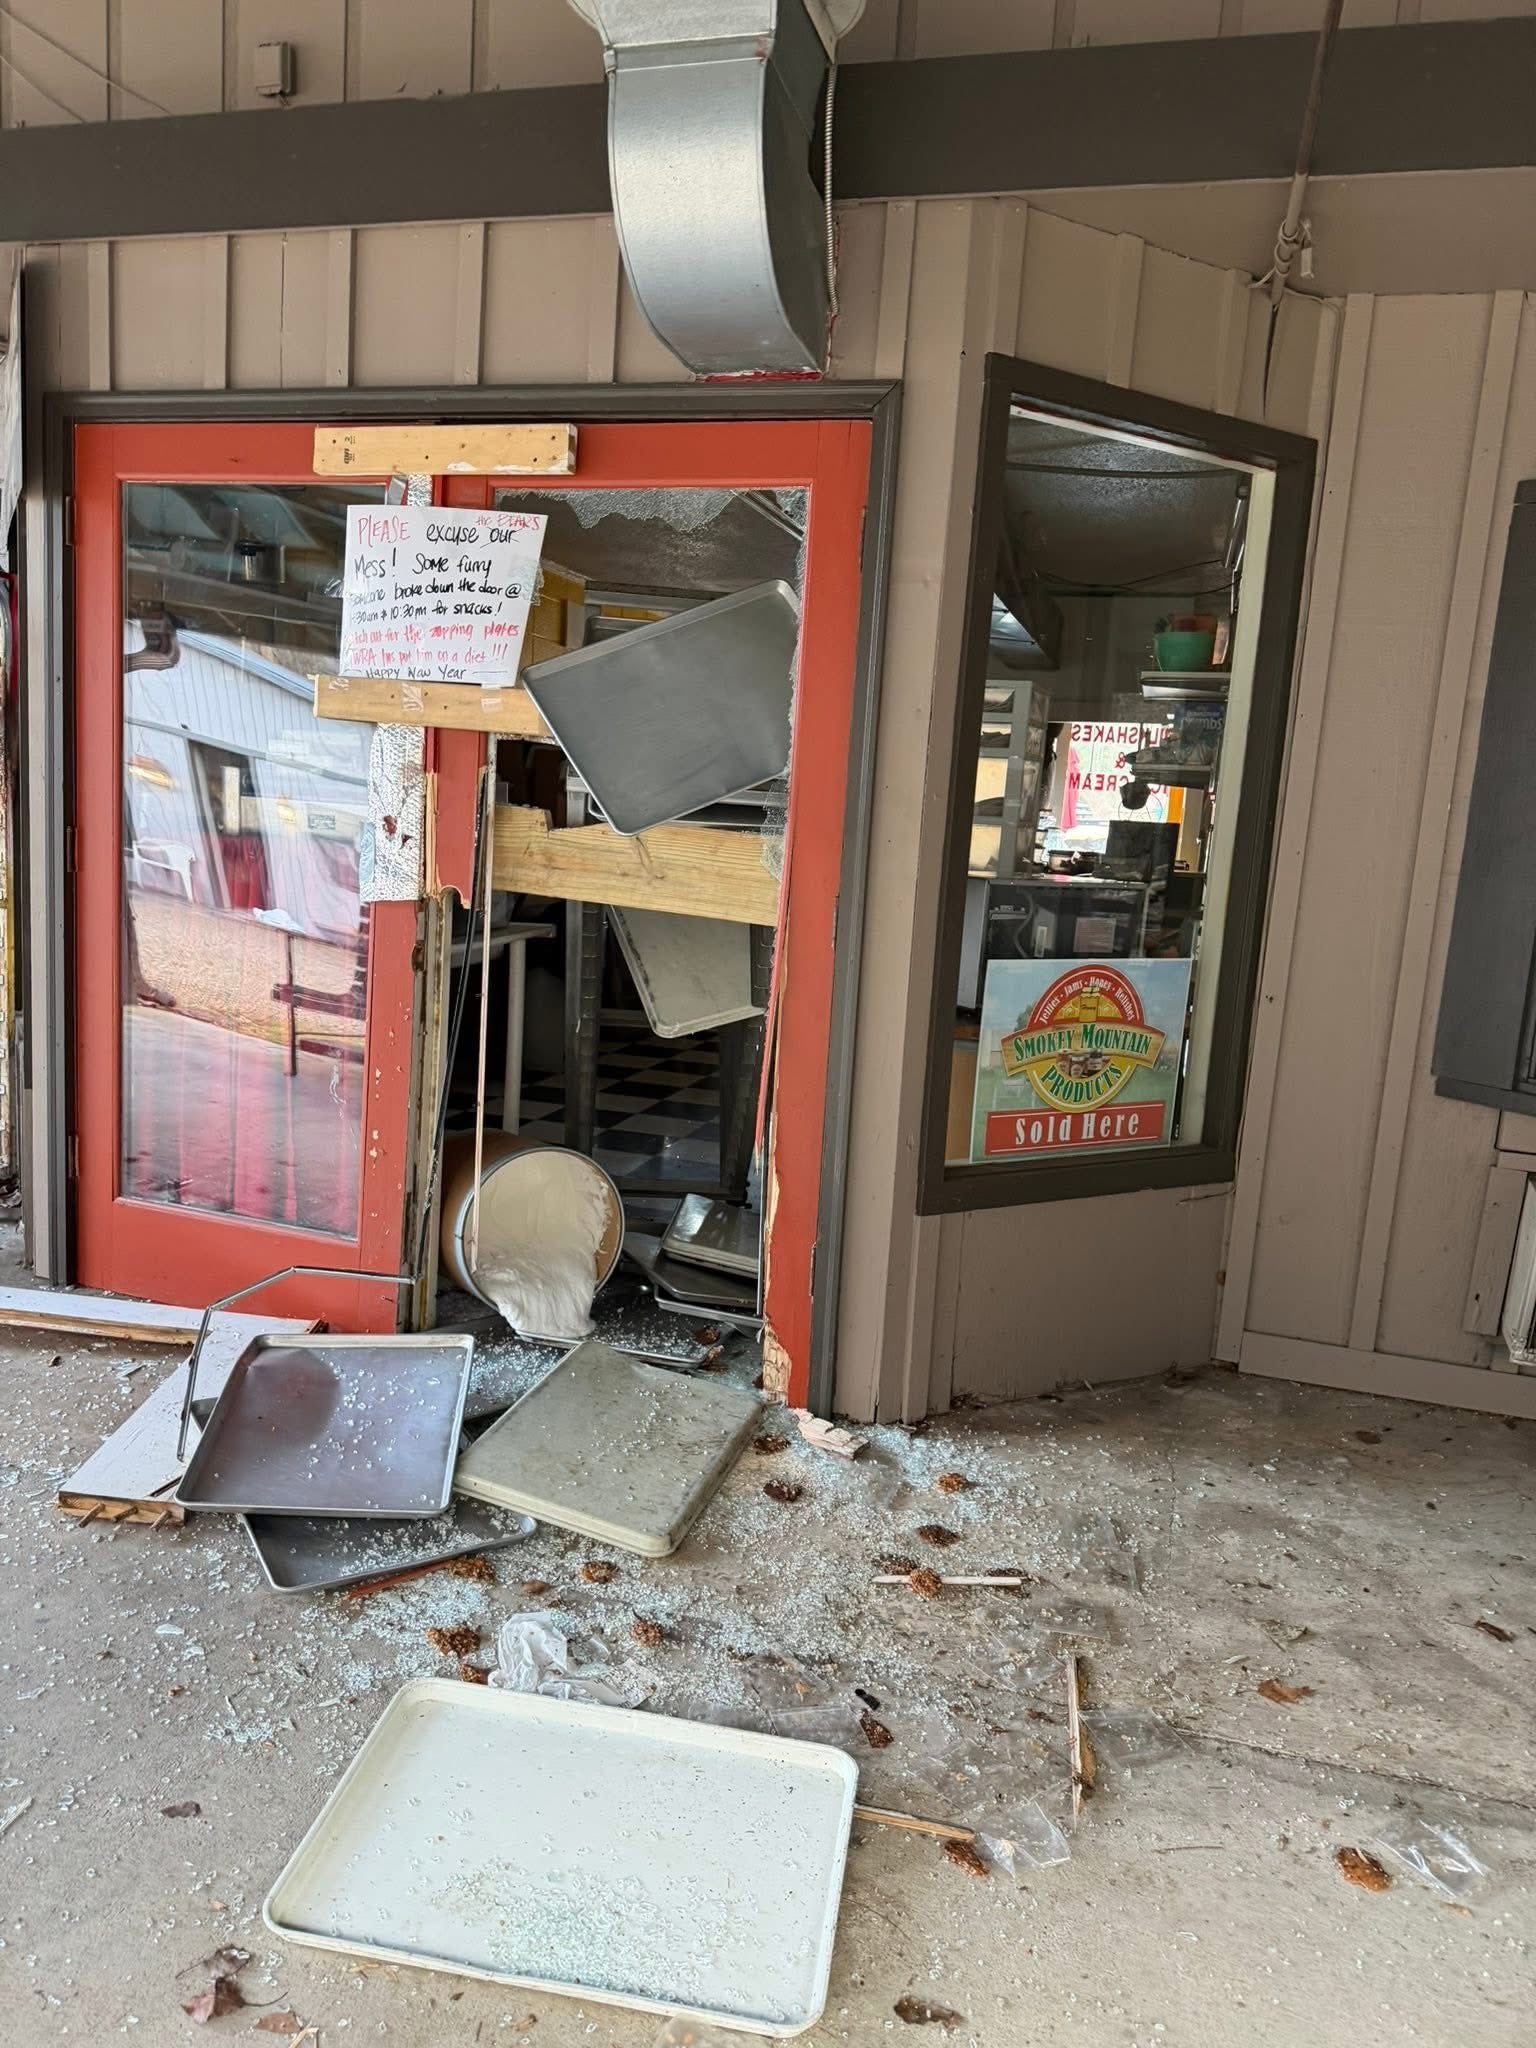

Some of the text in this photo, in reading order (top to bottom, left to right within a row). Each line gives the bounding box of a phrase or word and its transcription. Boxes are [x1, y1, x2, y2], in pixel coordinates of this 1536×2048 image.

[358, 515, 518, 548] PLEASE excuse our
[456, 554, 492, 579] furry
[394, 581, 424, 601] broke
[425, 577, 454, 594] down
[457, 577, 477, 593] the
[478, 580, 503, 596] door
[504, 582, 522, 598] @
[431, 599, 449, 616] for
[437, 650, 449, 662] on
[451, 651, 459, 662] a
[464, 647, 486, 664] diet
[438, 664, 467, 680] Year
[1064, 980, 1083, 997] Jams
[1089, 975, 1112, 992] Honey
[1080, 1023, 1152, 1055] MOUNTAIN
[1040, 1062, 1122, 1103] PRODUCTS
[1015, 1112, 1139, 1146] Sold Here
